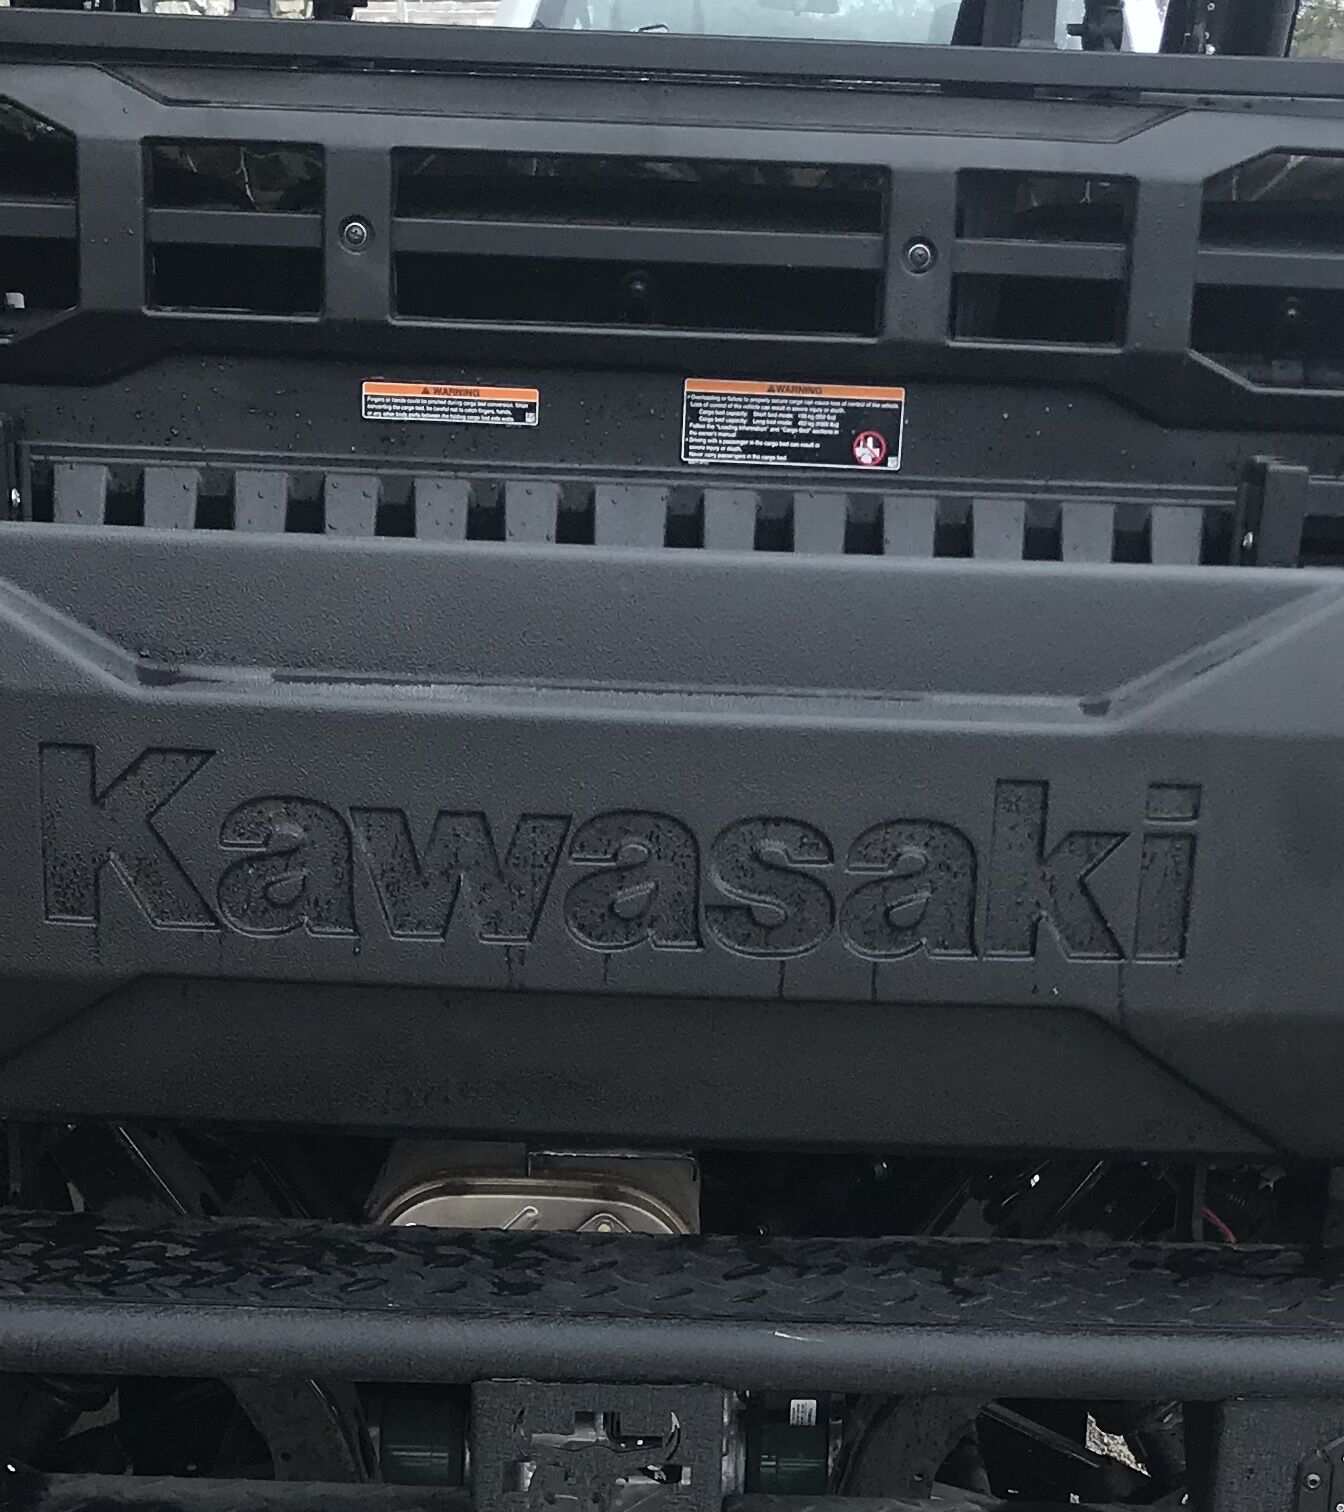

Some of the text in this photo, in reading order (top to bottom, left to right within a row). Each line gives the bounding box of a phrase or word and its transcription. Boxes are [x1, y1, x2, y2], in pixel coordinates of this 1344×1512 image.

[433, 387, 480, 397] WARNING
[777, 385, 822, 394] WARNING
[38, 742, 1204, 965] Kawasaki
